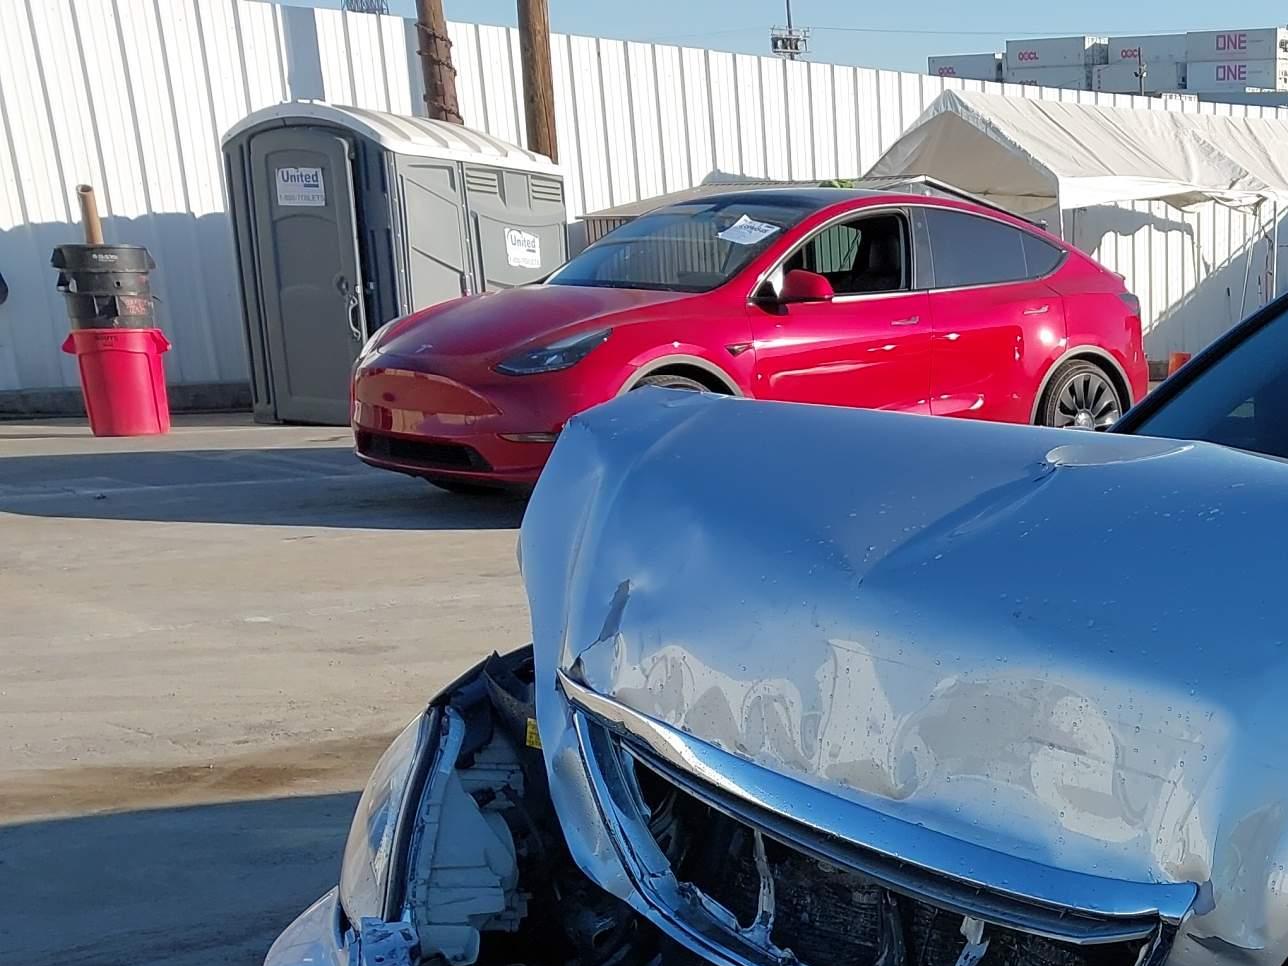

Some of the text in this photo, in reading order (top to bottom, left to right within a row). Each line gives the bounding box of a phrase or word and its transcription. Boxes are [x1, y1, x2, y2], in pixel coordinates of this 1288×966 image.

[1215, 34, 1247, 51] ONE
[1215, 64, 1247, 81] ONE
[280, 170, 319, 183] United
[510, 233, 536, 249] United
